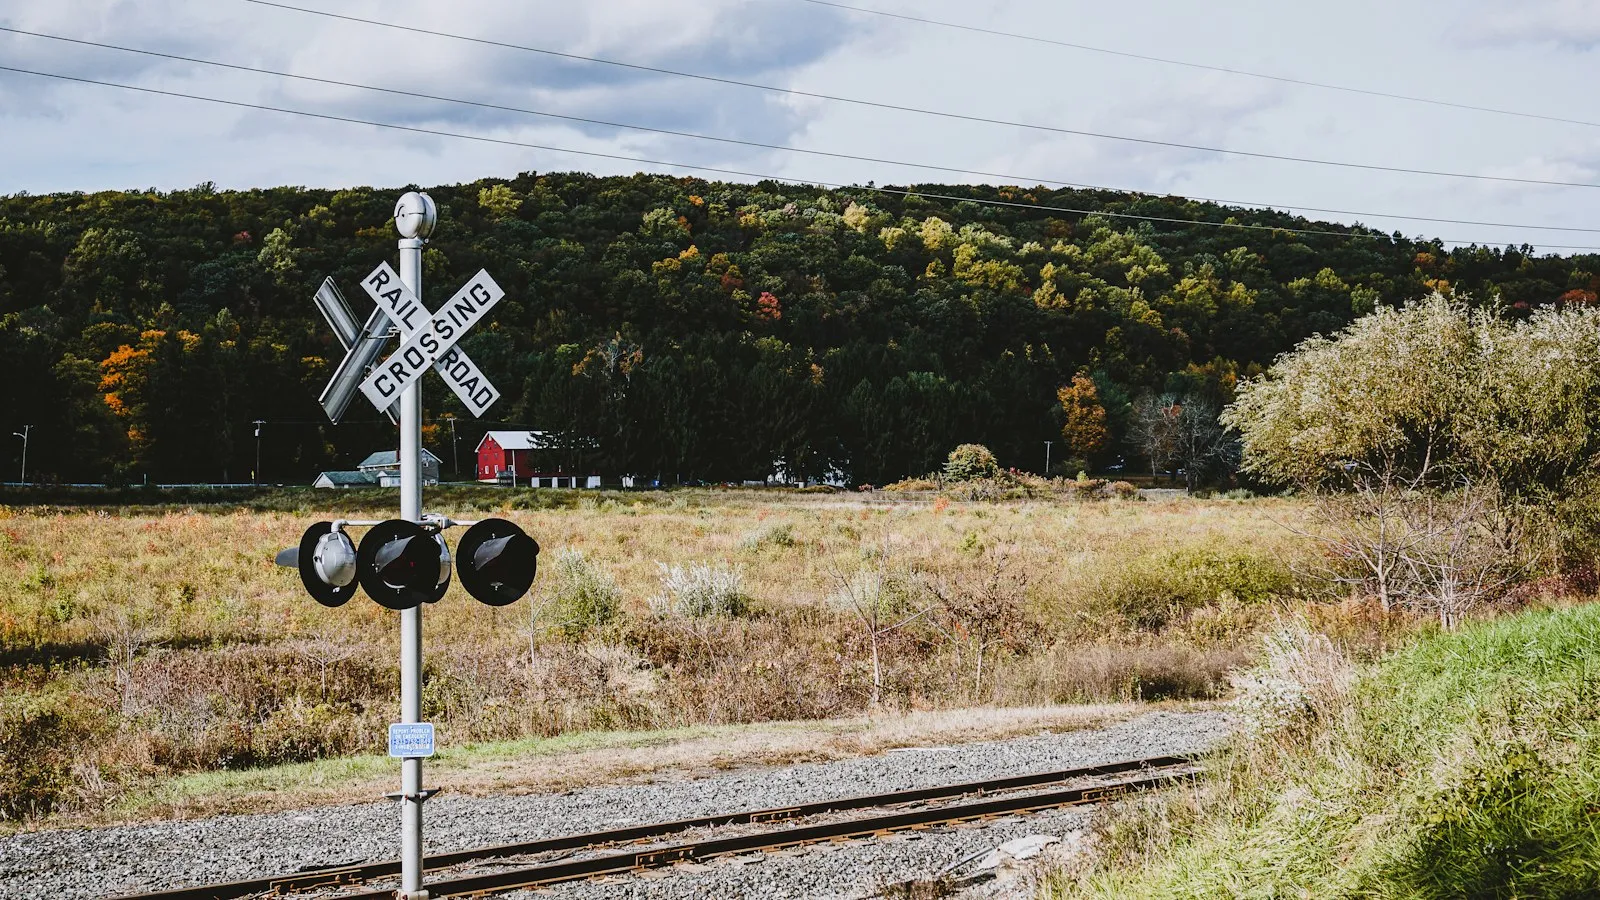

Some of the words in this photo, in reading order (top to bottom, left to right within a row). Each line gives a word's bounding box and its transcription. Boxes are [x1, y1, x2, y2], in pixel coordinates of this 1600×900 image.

[368, 269, 418, 331] RAIL
[438, 350, 493, 409] ROAD
[374, 283, 491, 398] CROSSING
